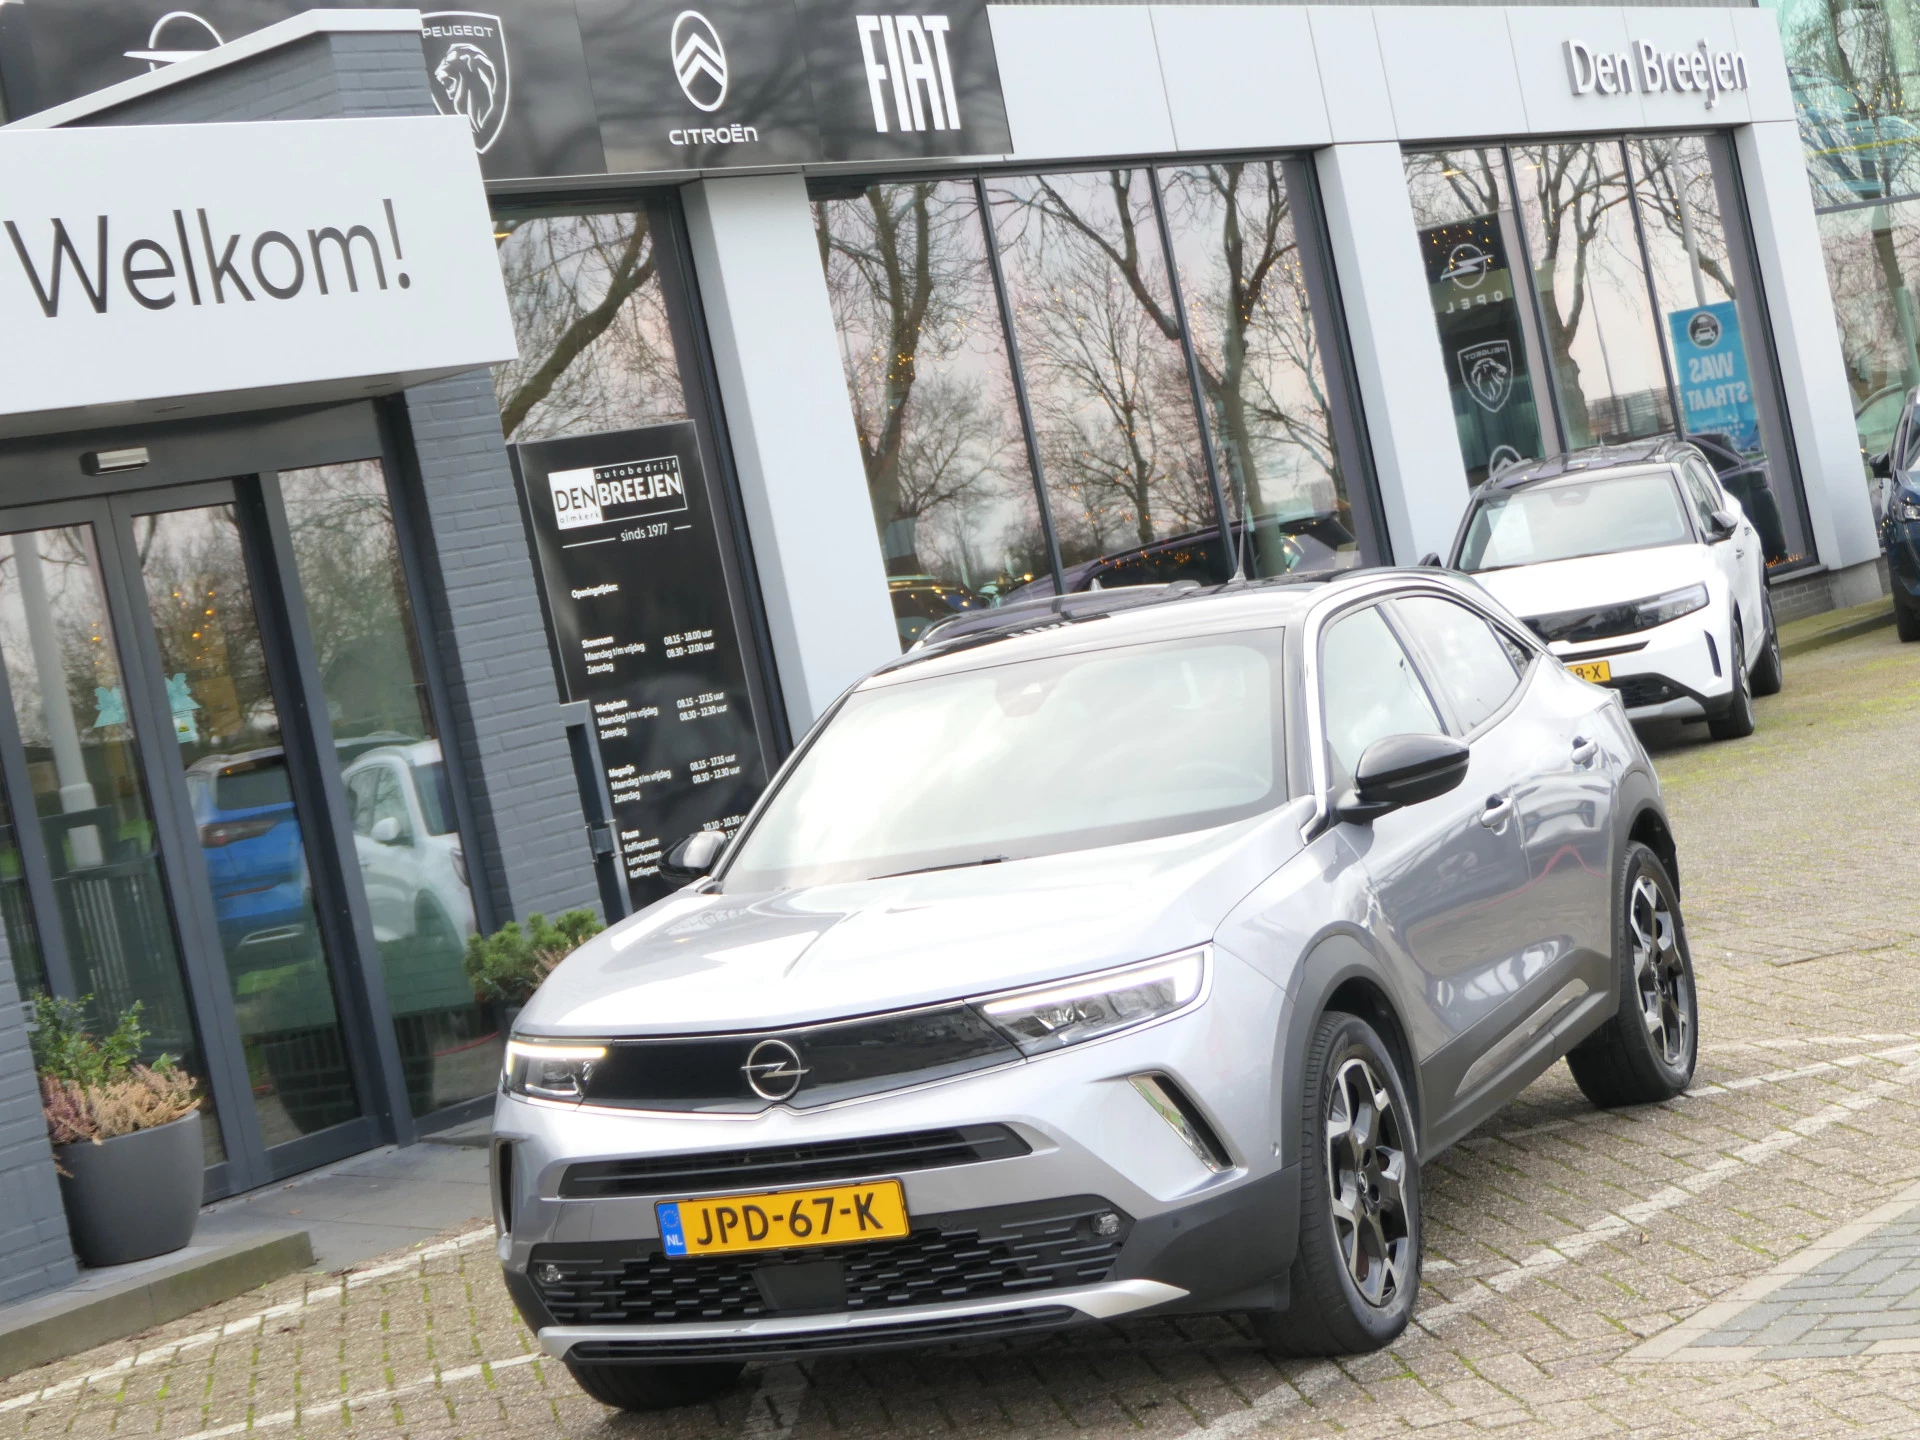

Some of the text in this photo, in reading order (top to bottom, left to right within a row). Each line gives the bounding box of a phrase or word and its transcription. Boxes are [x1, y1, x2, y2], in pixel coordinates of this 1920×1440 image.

[421, 25, 493, 38] PEUGEOT
[856, 15, 960, 132] FIAT
[1562, 37, 1748, 109] Den Breejen
[3, 198, 410, 317] Welkom!
[595, 459, 677, 480] autobedrijf
[598, 471, 682, 507] BREEJEN
[620, 522, 668, 542] sinds 1977
[702, 629, 713, 638] uur
[704, 642, 715, 651] uur
[584, 650, 613, 661] Maandag
[586, 662, 614, 675] Zaterdag
[713, 691, 724, 701] uur
[717, 704, 728, 713] uur
[597, 714, 626, 726] Maandag
[600, 727, 627, 740] Zaterdag
[611, 778, 639, 790] Maandag
[613, 790, 641, 804] Zaterdag
[629, 865, 660, 879] Koffiepau
[697, 1192, 884, 1246] JPD-67-K
[666, 1233, 683, 1247] NL
